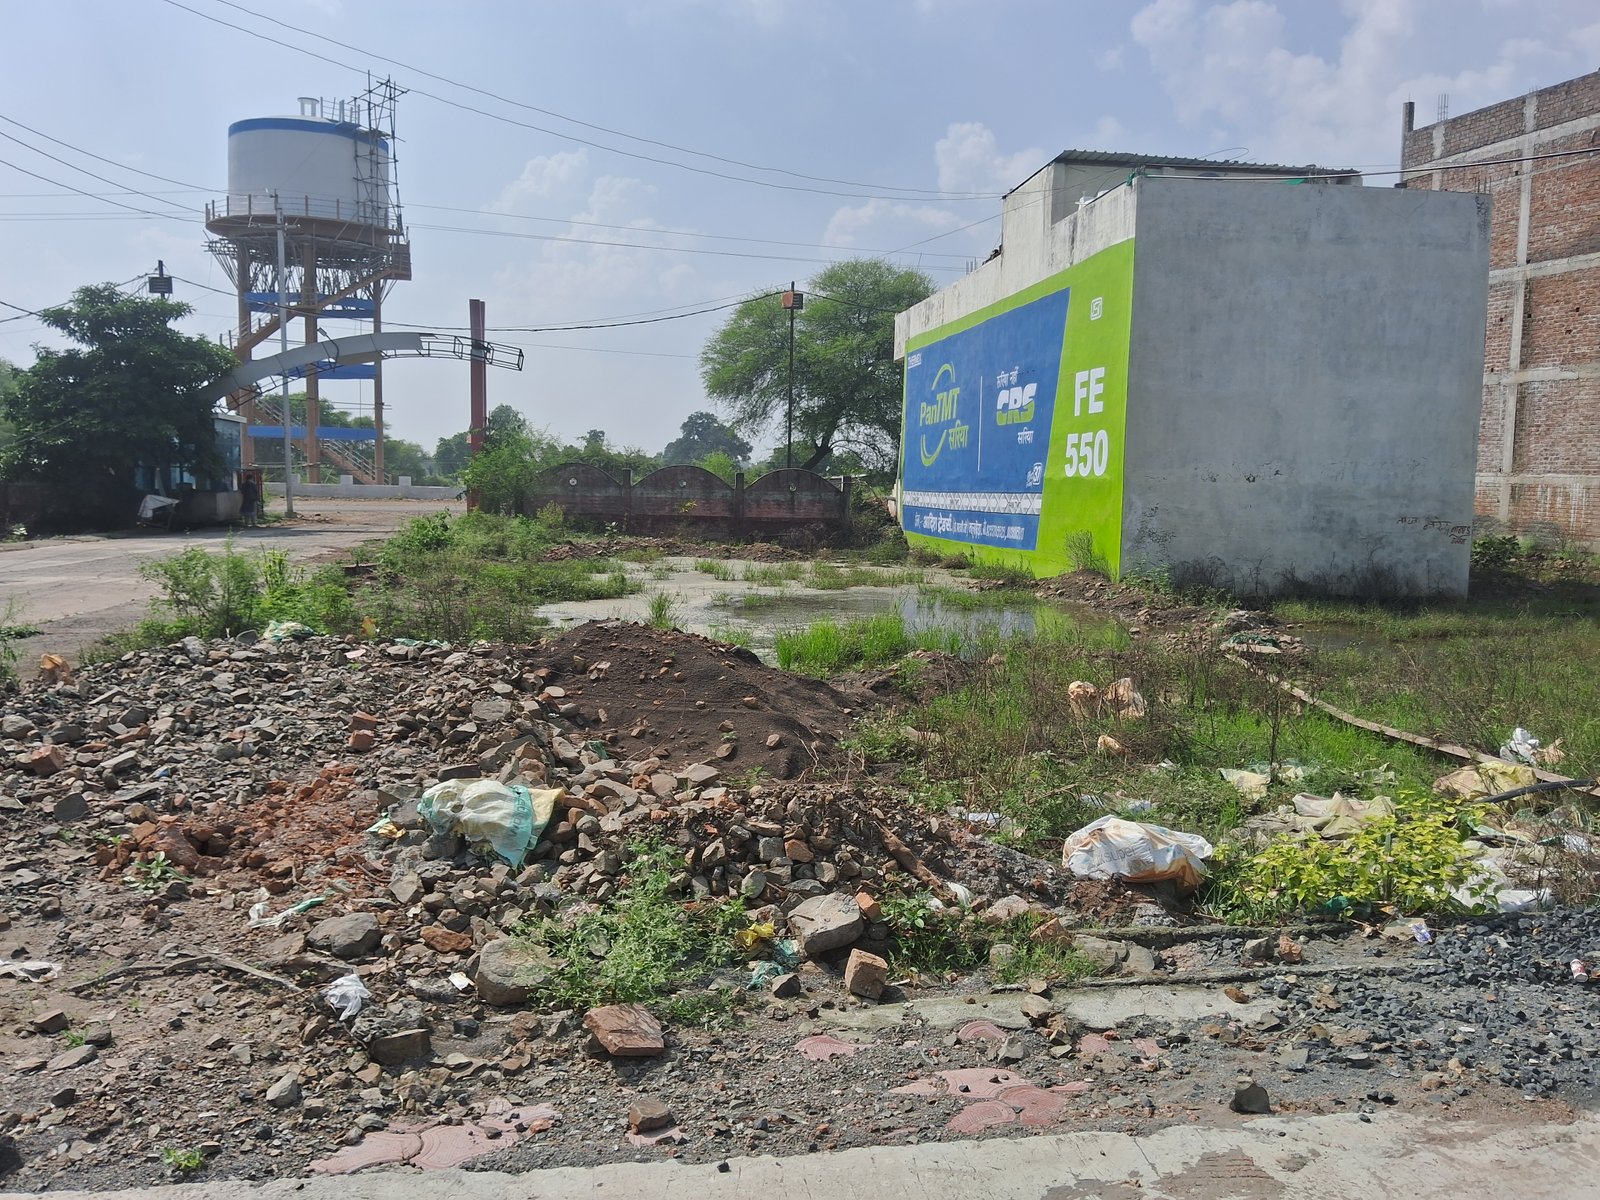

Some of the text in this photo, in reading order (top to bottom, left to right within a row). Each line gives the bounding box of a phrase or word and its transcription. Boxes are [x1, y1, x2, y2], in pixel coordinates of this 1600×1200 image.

[1074, 367, 1105, 416] FE
[948, 419, 969, 450] सरिया
[1017, 427, 1034, 445] सरिया
[1064, 430, 1109, 477] 550
